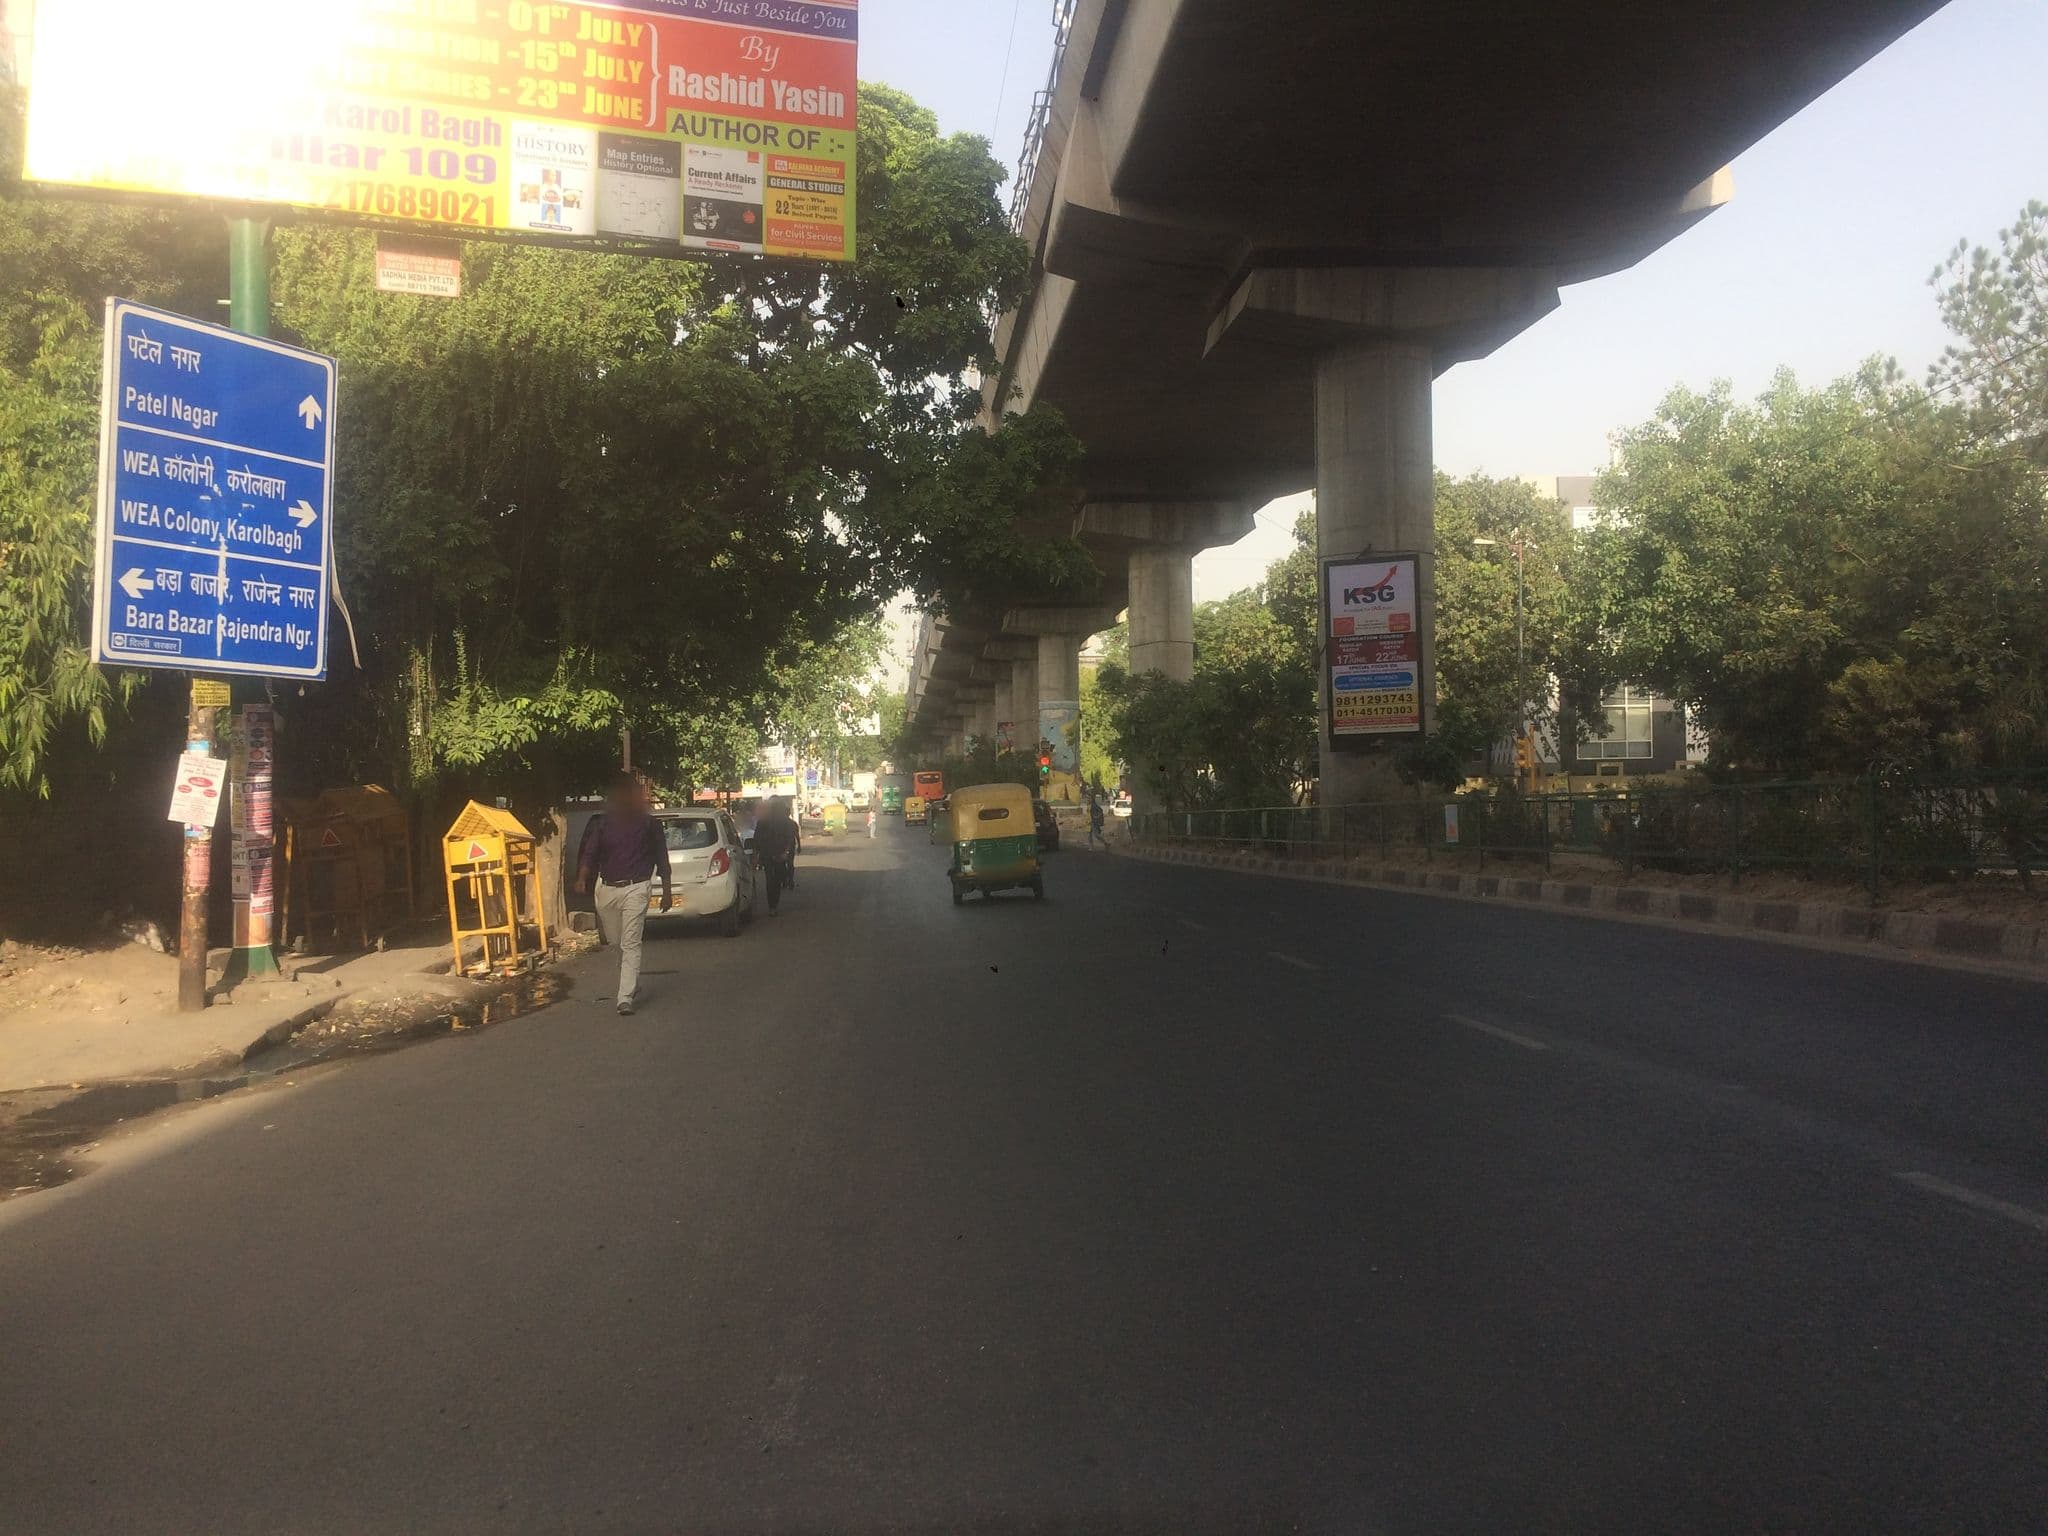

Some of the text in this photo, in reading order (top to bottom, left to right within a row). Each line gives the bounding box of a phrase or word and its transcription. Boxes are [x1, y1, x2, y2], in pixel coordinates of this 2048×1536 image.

[576, 10, 643, 47] JULY
[712, 0, 750, 16] Just
[755, 1, 809, 25] Beside
[814, 10, 847, 30] You
[583, 47, 644, 84] JULY
[739, 35, 781, 72] By
[583, 85, 643, 121] JUNE
[668, 64, 845, 118] Rashid Yasin
[323, 102, 502, 148] Karol Bagh
[671, 113, 779, 147] AUTHOR
[787, 129, 821, 151] OF
[271, 133, 497, 185] illar 109
[516, 136, 588, 157] HISTORY
[607, 148, 665, 165] Map Entries
[604, 158, 673, 174] History Optional
[688, 167, 757, 185] Current Affairs
[770, 177, 844, 194] GENERAL STUDIES
[776, 200, 789, 215] 22
[771, 228, 783, 236] for
[785, 229, 804, 239] Civil
[806, 232, 842, 242] Services
[127, 328, 201, 373] पटेल नगर
[126, 386, 218, 430] Patel Nagar
[123, 449, 160, 478] WEA
[226, 464, 286, 501] करोलबाग
[121, 499, 160, 528] WEA
[227, 517, 302, 554] Karolbagh
[155, 567, 316, 609] बड़ा बाजर, राजेन्द्र नगर
[1343, 584, 1395, 606] KSG
[126, 604, 314, 650] Bara Bazar Rajendra Ngr.
[1336, 693, 1413, 707] 9811293743
[1336, 706, 1413, 717] 011-45170303
